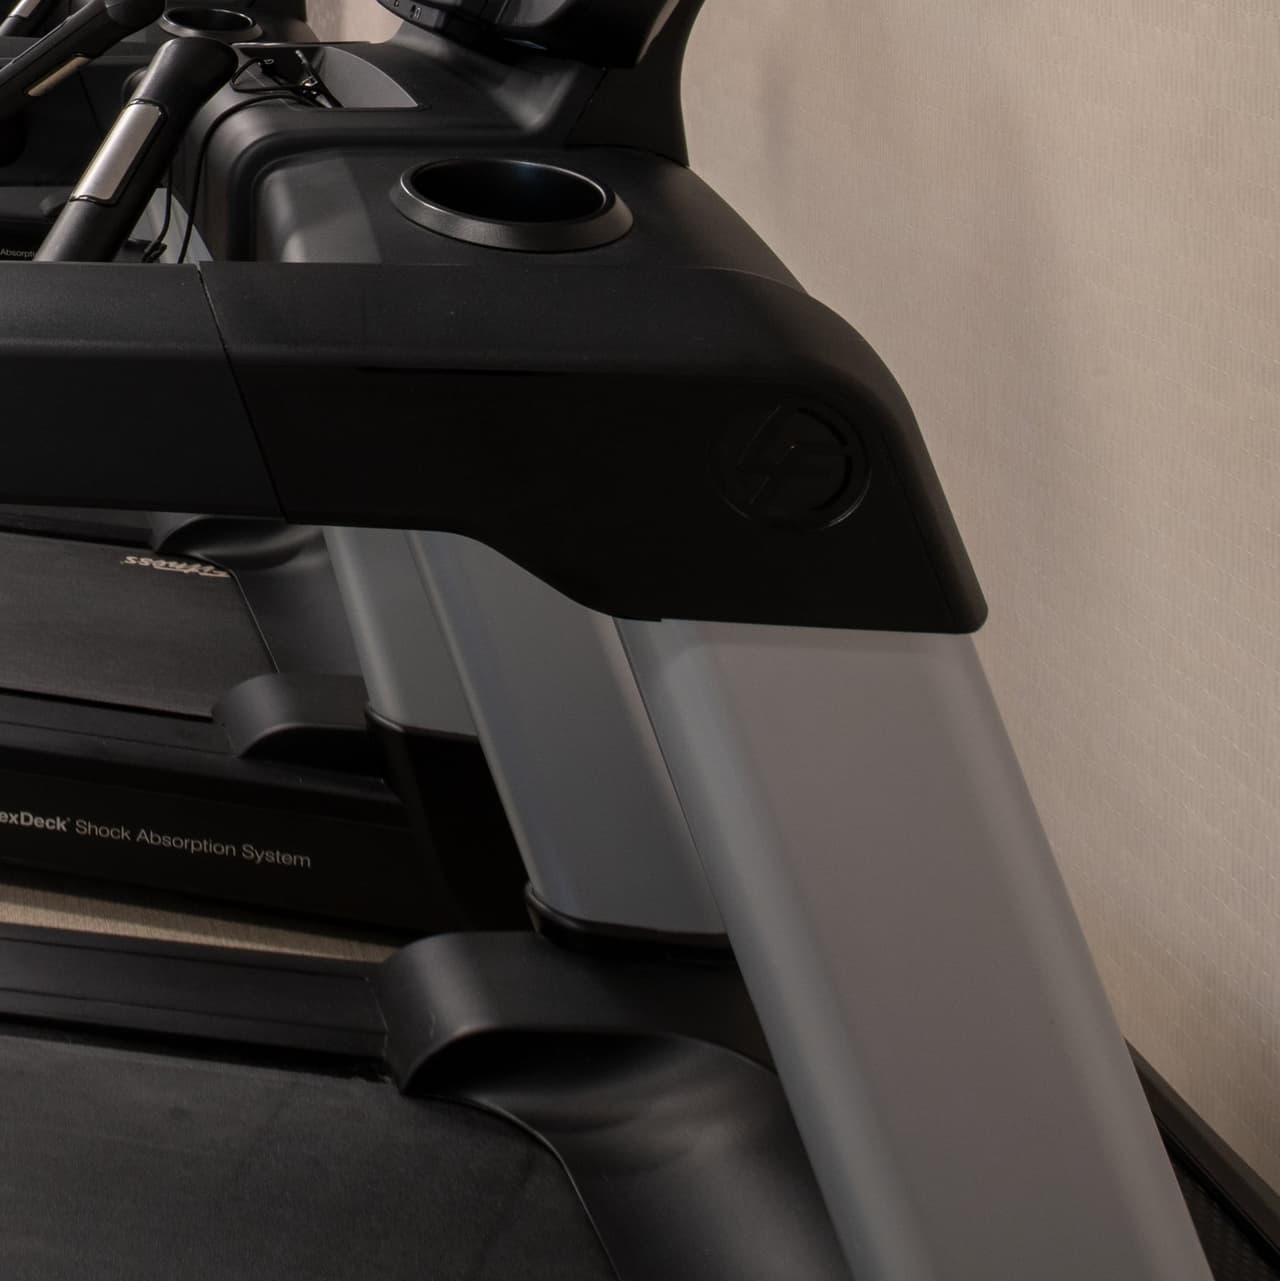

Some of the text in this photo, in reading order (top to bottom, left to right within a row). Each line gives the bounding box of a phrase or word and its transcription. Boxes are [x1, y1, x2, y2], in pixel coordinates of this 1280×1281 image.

[0, 247, 36, 259] Absorpti
[75, 819, 132, 841] Shock
[136, 829, 237, 857] Absorption
[241, 844, 312, 869] System
